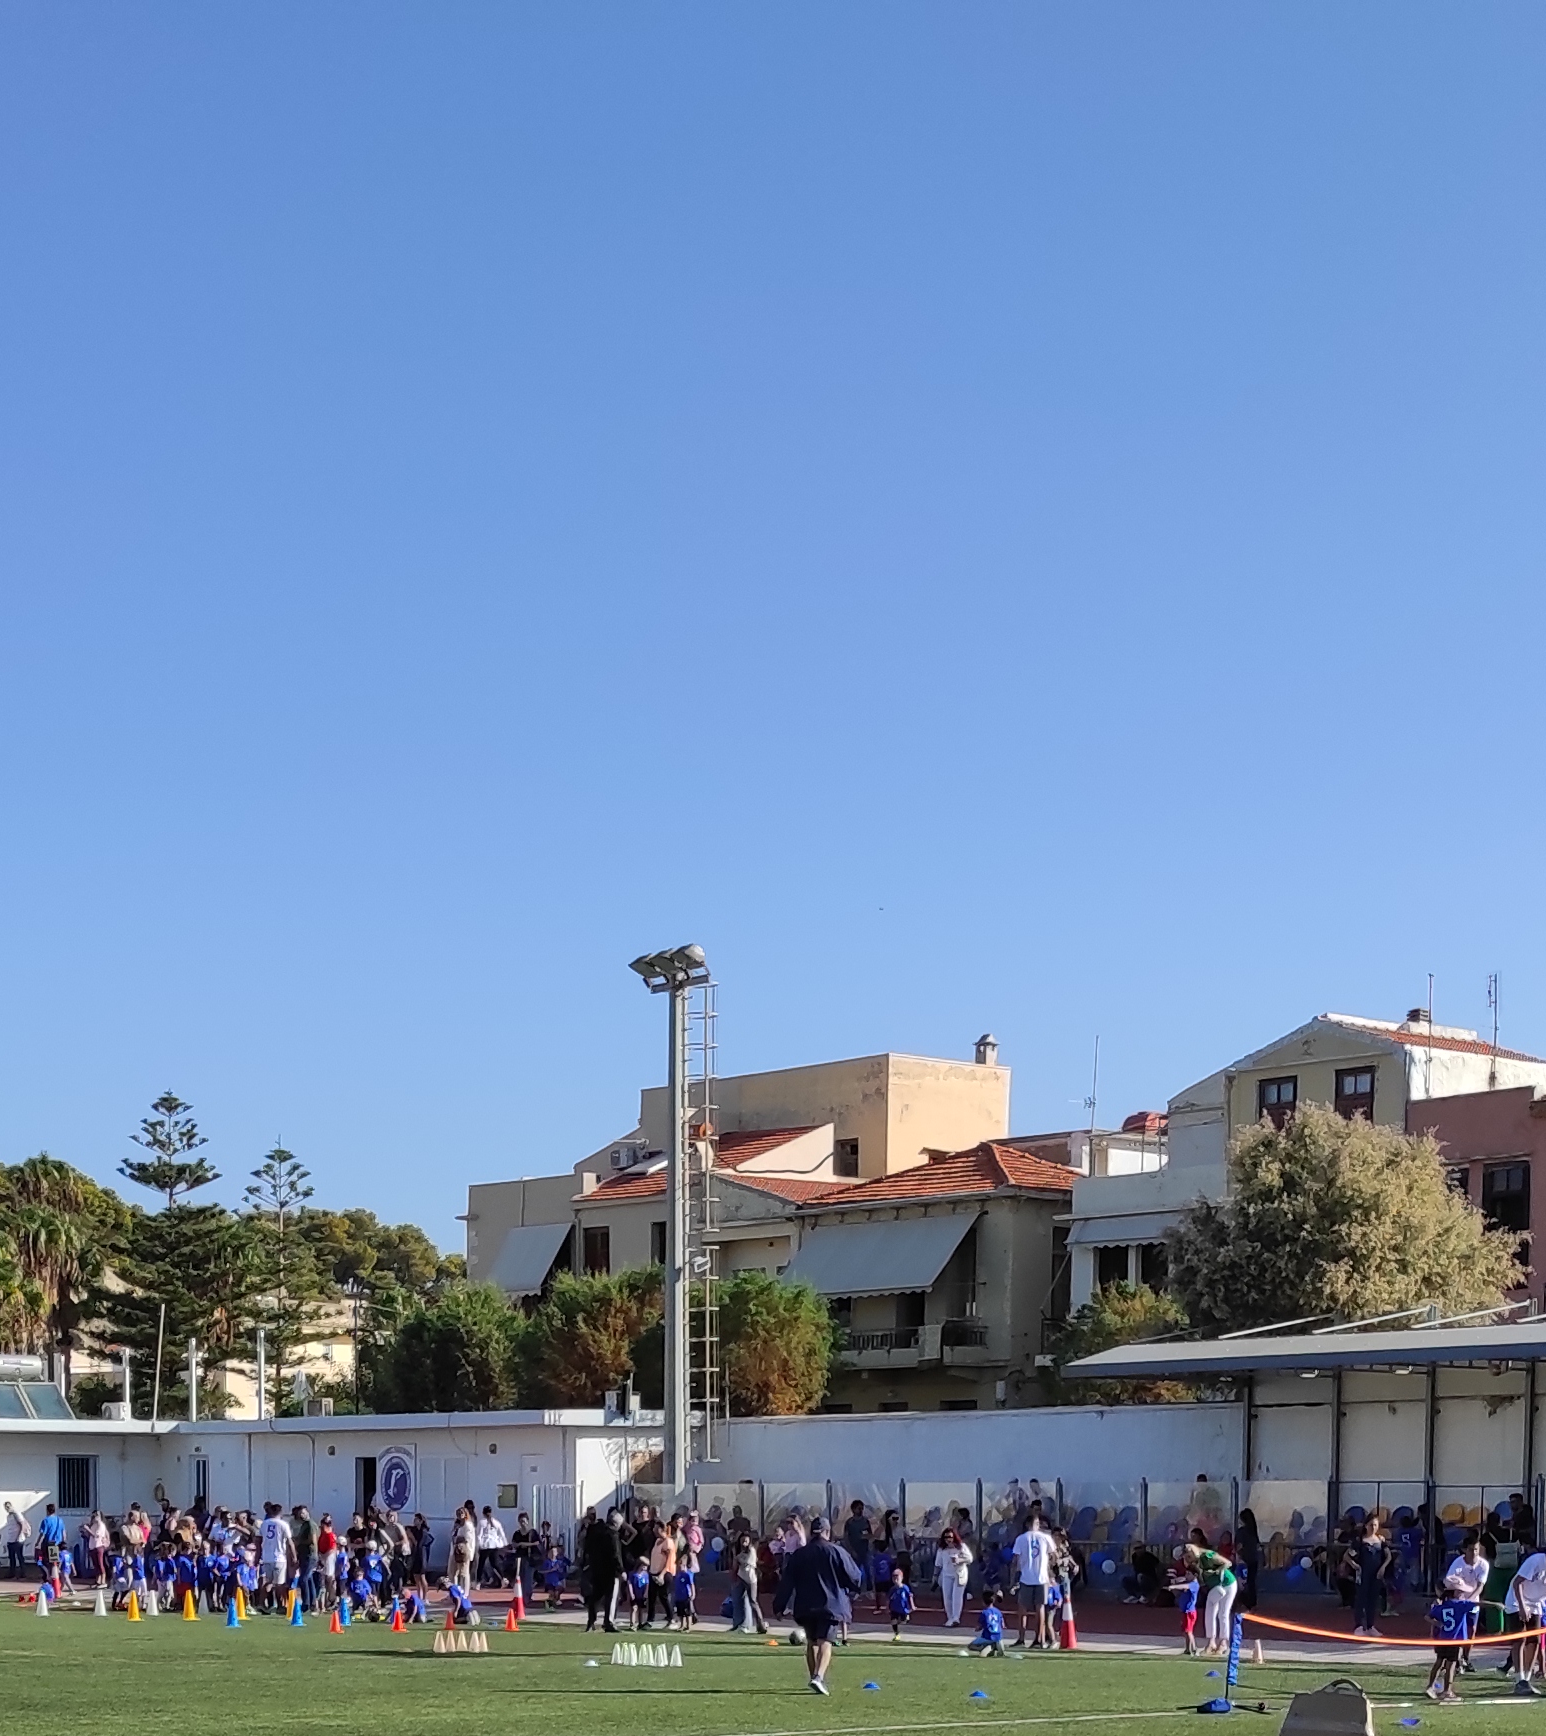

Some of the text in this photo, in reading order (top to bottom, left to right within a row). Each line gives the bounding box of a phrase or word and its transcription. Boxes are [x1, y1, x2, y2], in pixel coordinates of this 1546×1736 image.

[266, 1524, 276, 1540] 5
[1401, 1533, 1412, 1548] 5
[1442, 1607, 1456, 1632] 5
